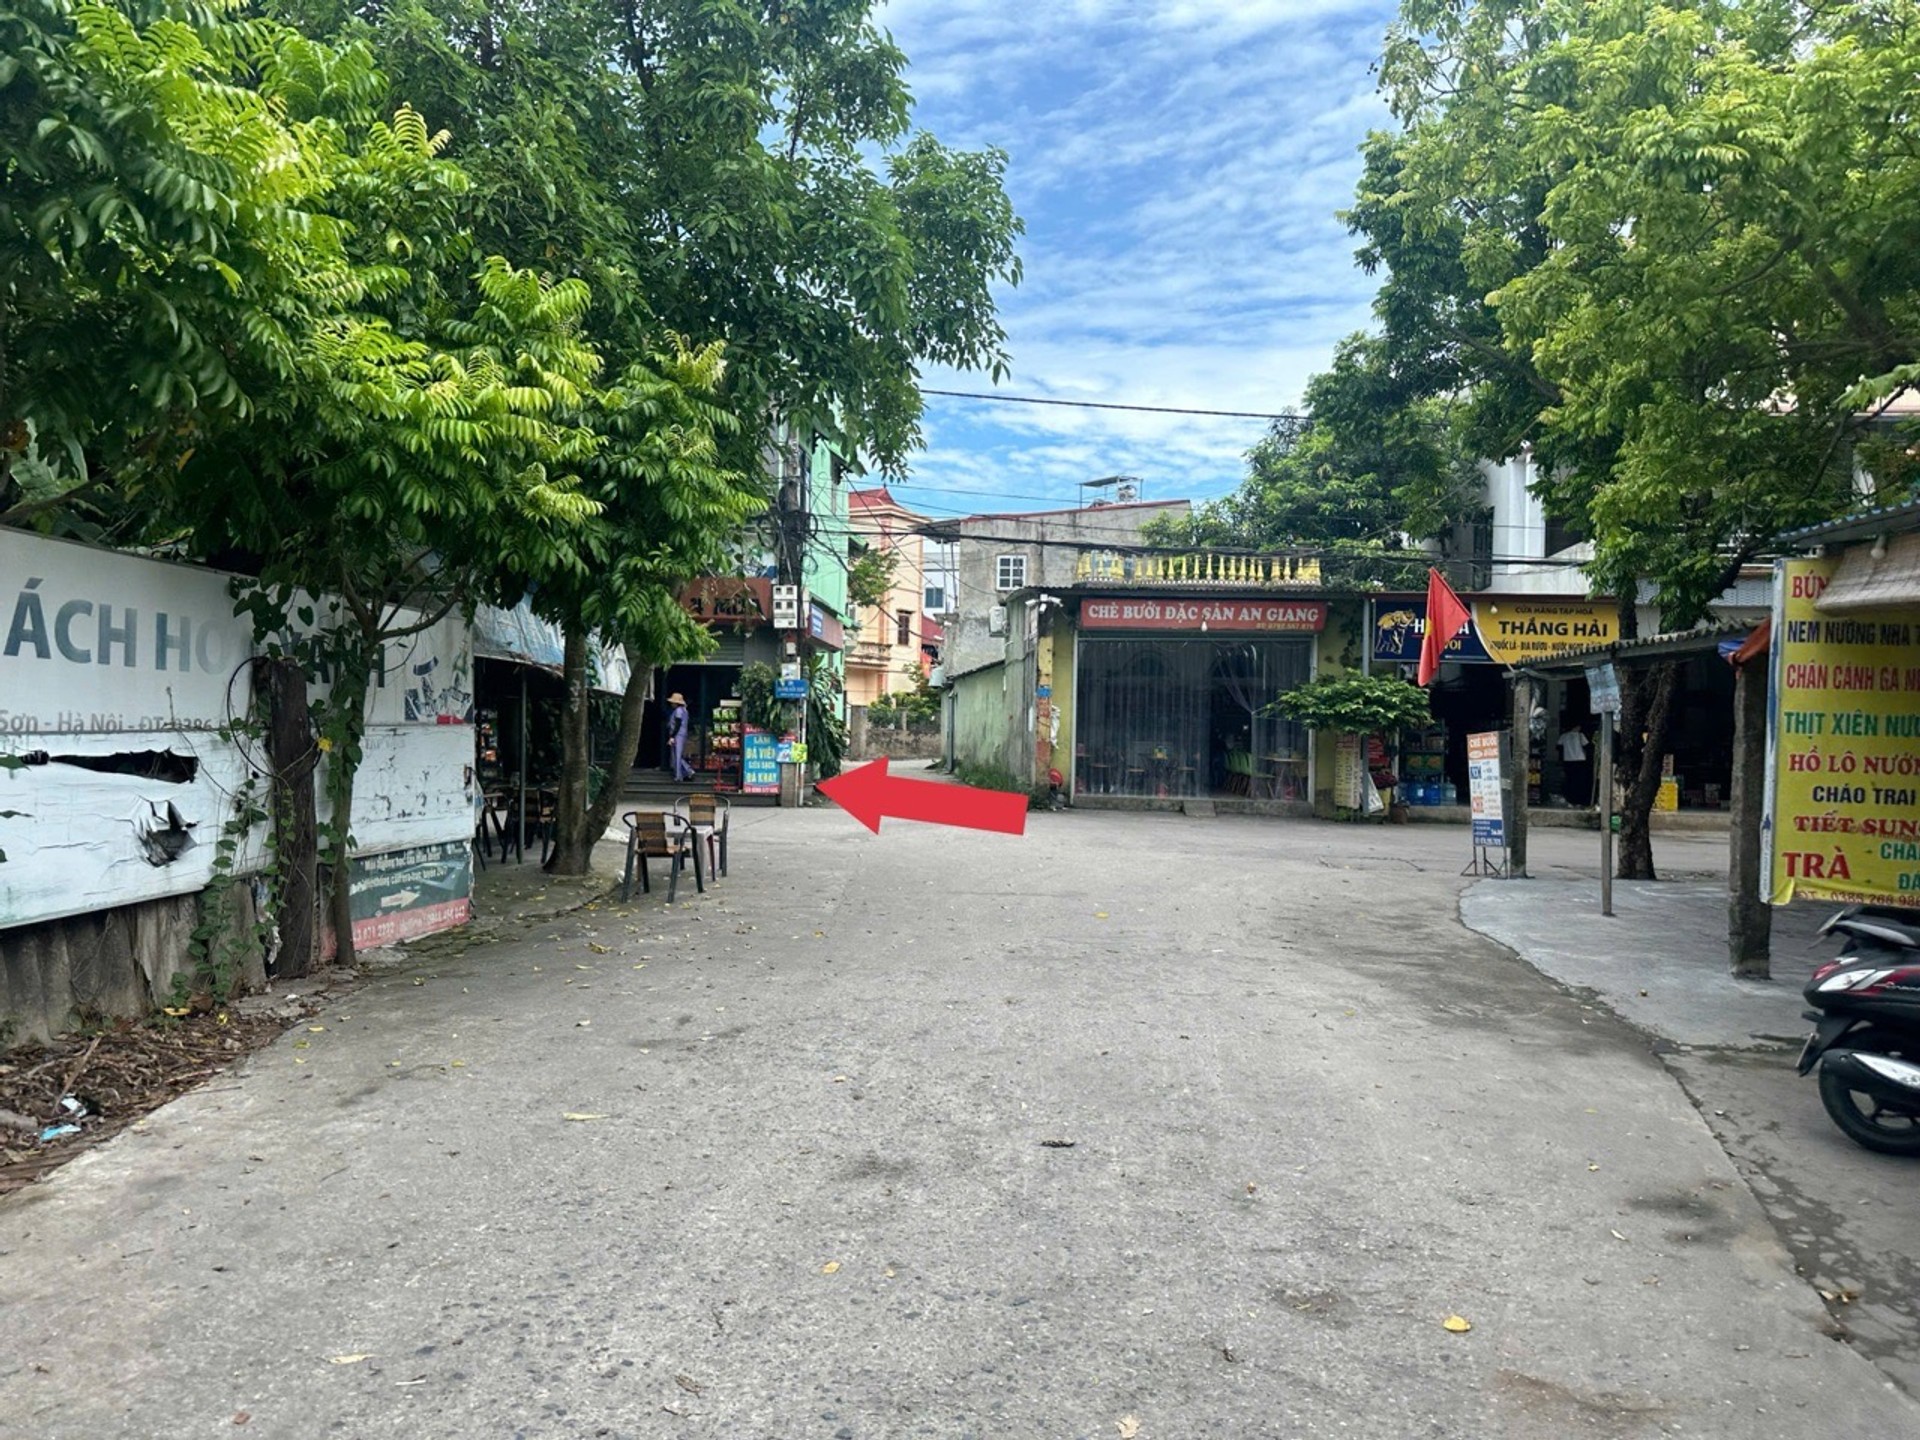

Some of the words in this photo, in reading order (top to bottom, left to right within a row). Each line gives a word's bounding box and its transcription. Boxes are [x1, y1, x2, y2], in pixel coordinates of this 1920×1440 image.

[1088, 601, 1119, 619] CHÈ
[1123, 601, 1160, 620] BƯỞI
[1165, 603, 1198, 623] ĐẶC
[1201, 603, 1234, 621] SẢN
[1238, 607, 1262, 621] AN
[1266, 607, 1319, 622] GIANG
[1498, 617, 1569, 636] THẮNG
[1573, 619, 1608, 637] HẢI
[1787, 620, 1820, 643] NEM
[155, 612, 247, 677] HO
[1786, 659, 1828, 689] CHÂN
[58, 709, 85, 732] Hà
[1784, 711, 1825, 739] THỊT
[1832, 708, 1878, 736] XIÊN
[1828, 750, 1856, 773] LÔ
[1812, 783, 1866, 804] CHÁO
[1873, 787, 1916, 806] TRAI
[1794, 810, 1854, 833] TIẾT
[1861, 818, 1920, 837] SUN
[1781, 845, 1851, 879] TRÀ
[1880, 842, 1920, 860] CHA
